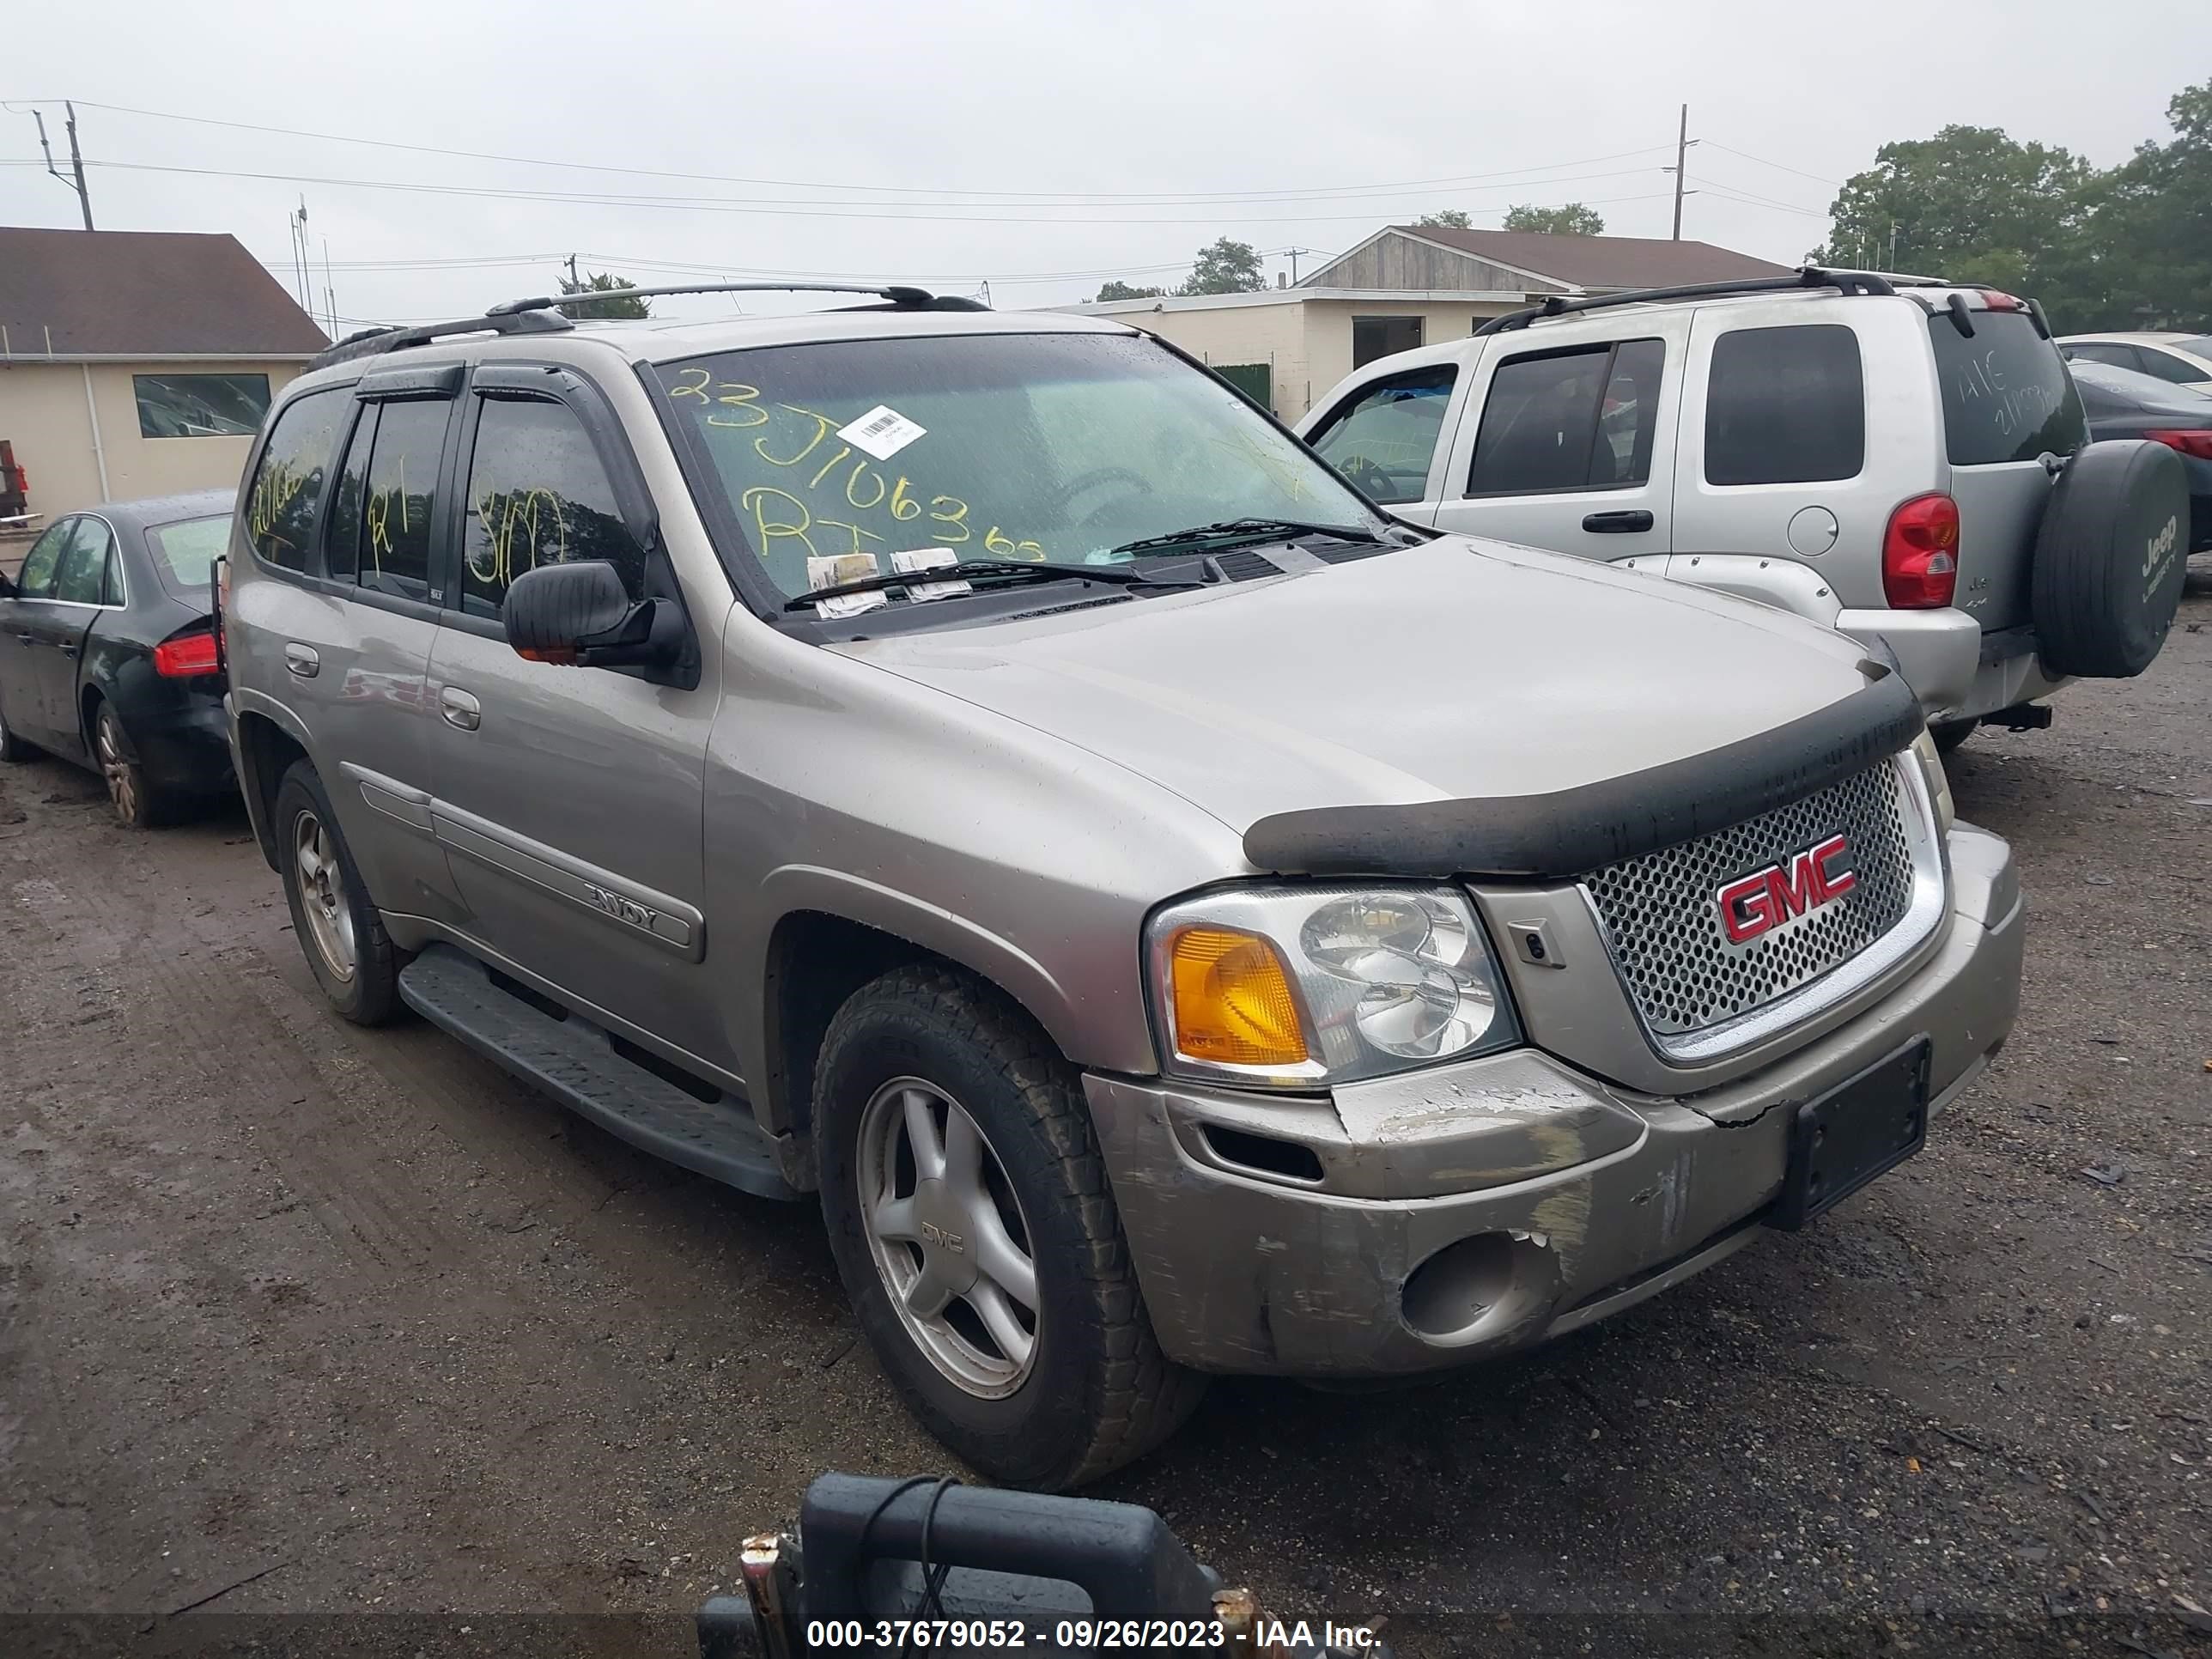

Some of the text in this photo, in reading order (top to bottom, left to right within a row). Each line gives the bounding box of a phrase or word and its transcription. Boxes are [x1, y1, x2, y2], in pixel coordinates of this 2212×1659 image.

[2142, 515, 2177, 577] Jeep
[430, 588, 443, 601] SLT
[584, 883, 658, 930] ENVOY
[1717, 830, 1856, 945] GMC
[921, 1221, 963, 1255] GMC
